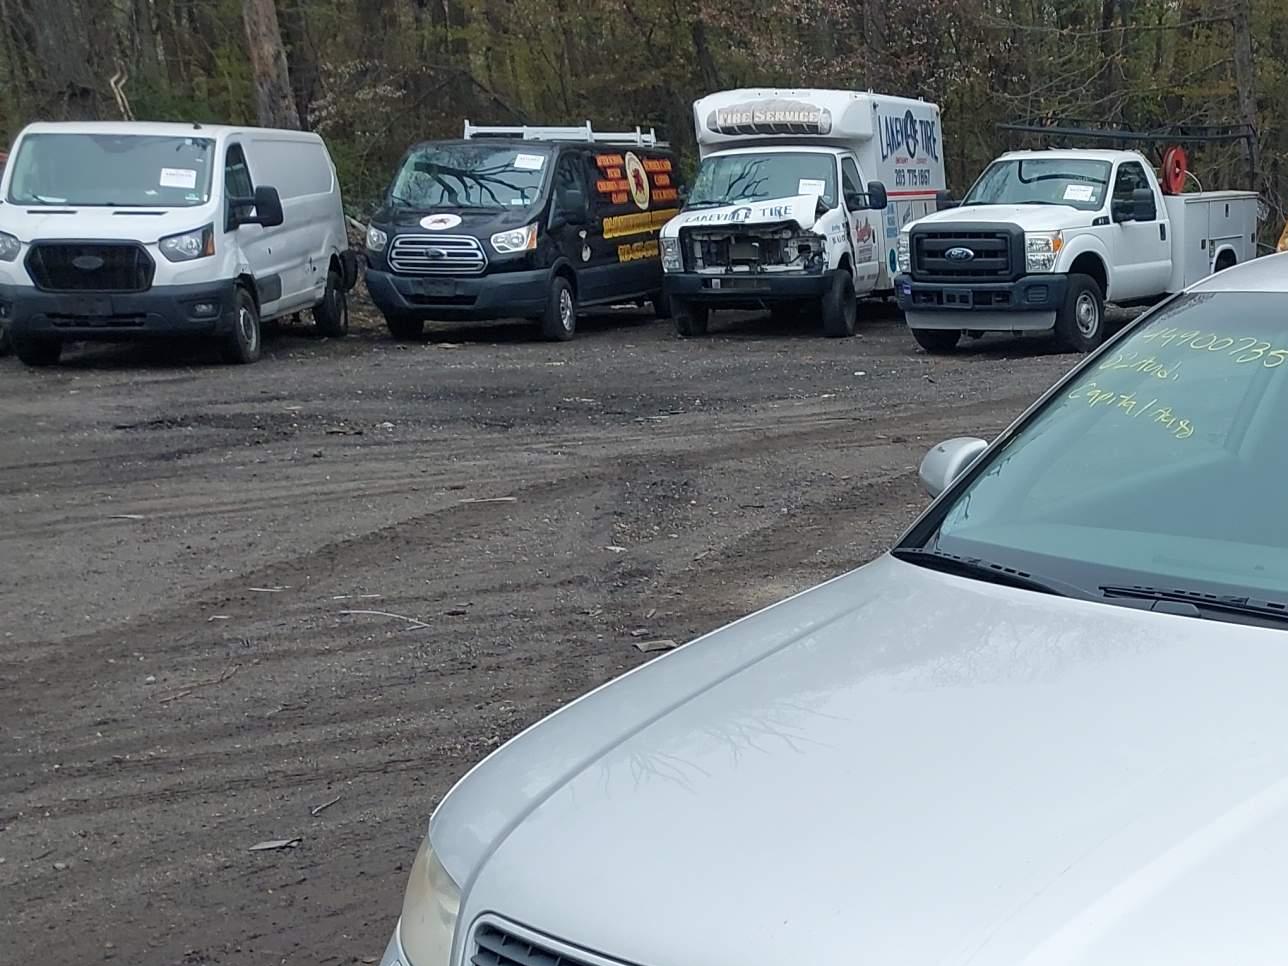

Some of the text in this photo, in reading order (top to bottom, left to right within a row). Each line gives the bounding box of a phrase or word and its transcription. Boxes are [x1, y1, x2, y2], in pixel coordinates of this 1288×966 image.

[754, 109, 819, 122] SERVICE
[919, 119, 938, 162] TIRE
[760, 205, 793, 220] TIRE
